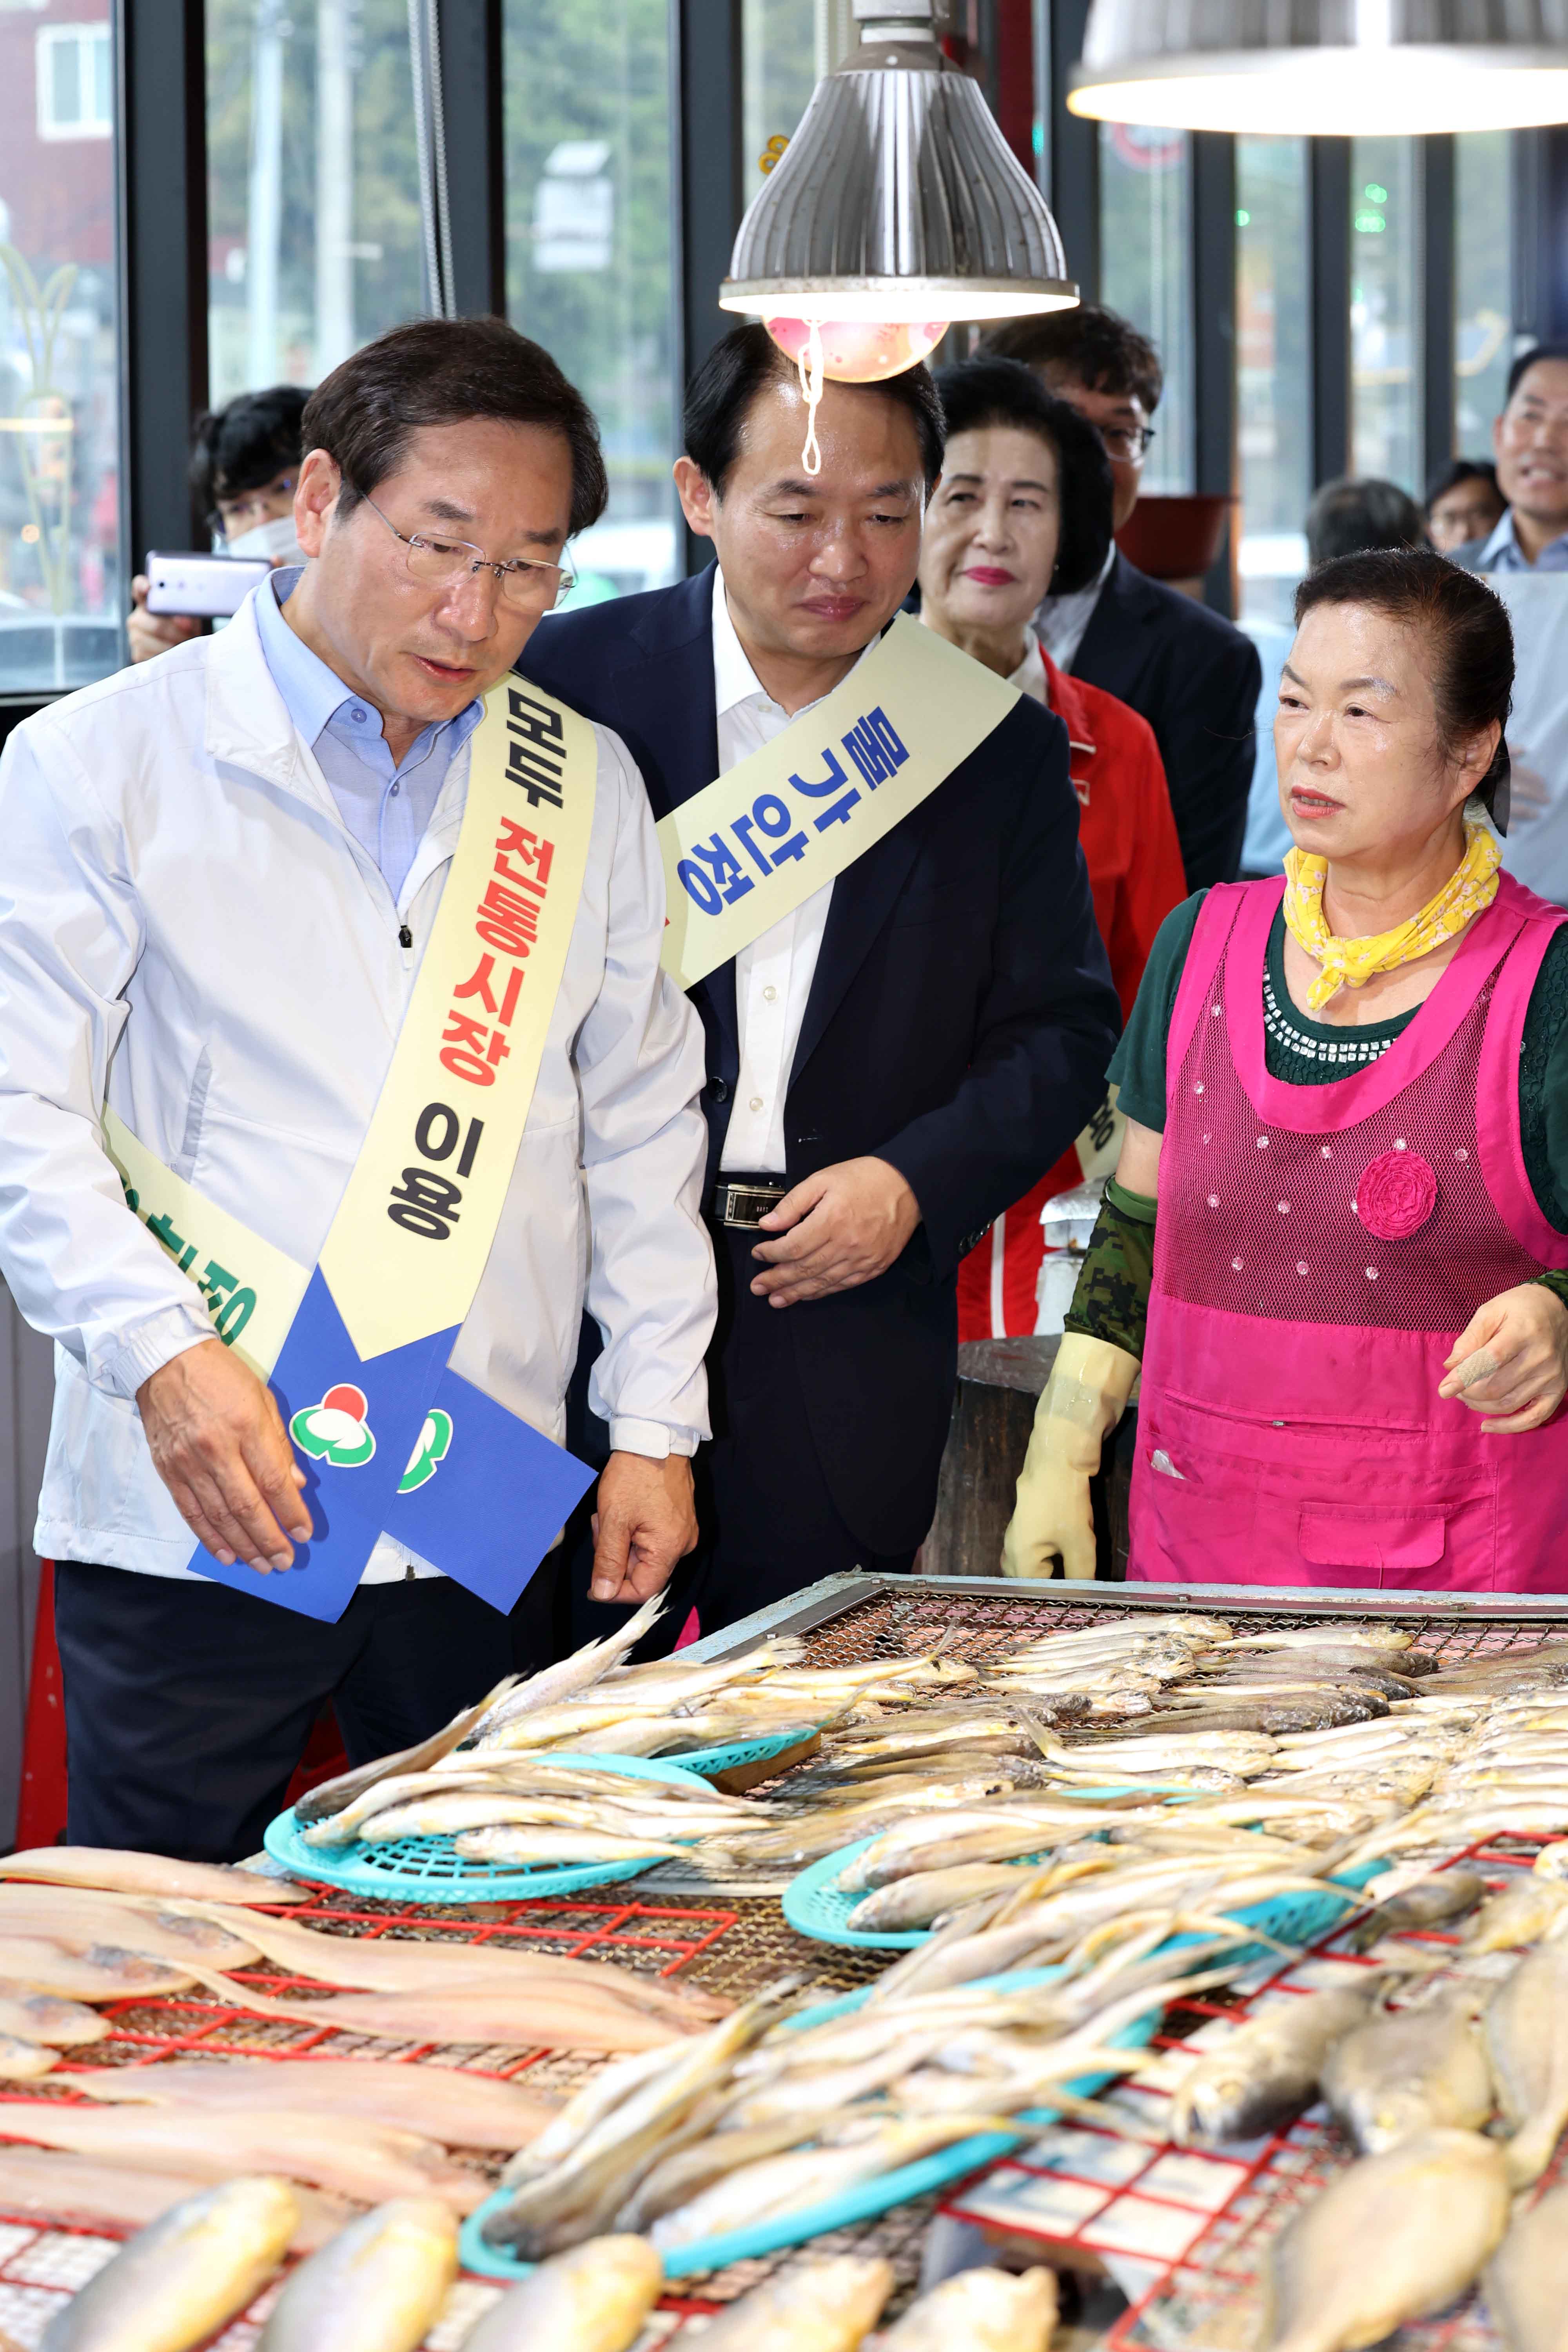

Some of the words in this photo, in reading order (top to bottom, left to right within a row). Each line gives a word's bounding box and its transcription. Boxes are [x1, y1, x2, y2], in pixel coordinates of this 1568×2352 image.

[506, 687, 567, 809] 모두
[677, 706, 910, 916] 물가안정
[439, 816, 555, 1087] 전통시장
[387, 1102, 485, 1240] 이용
